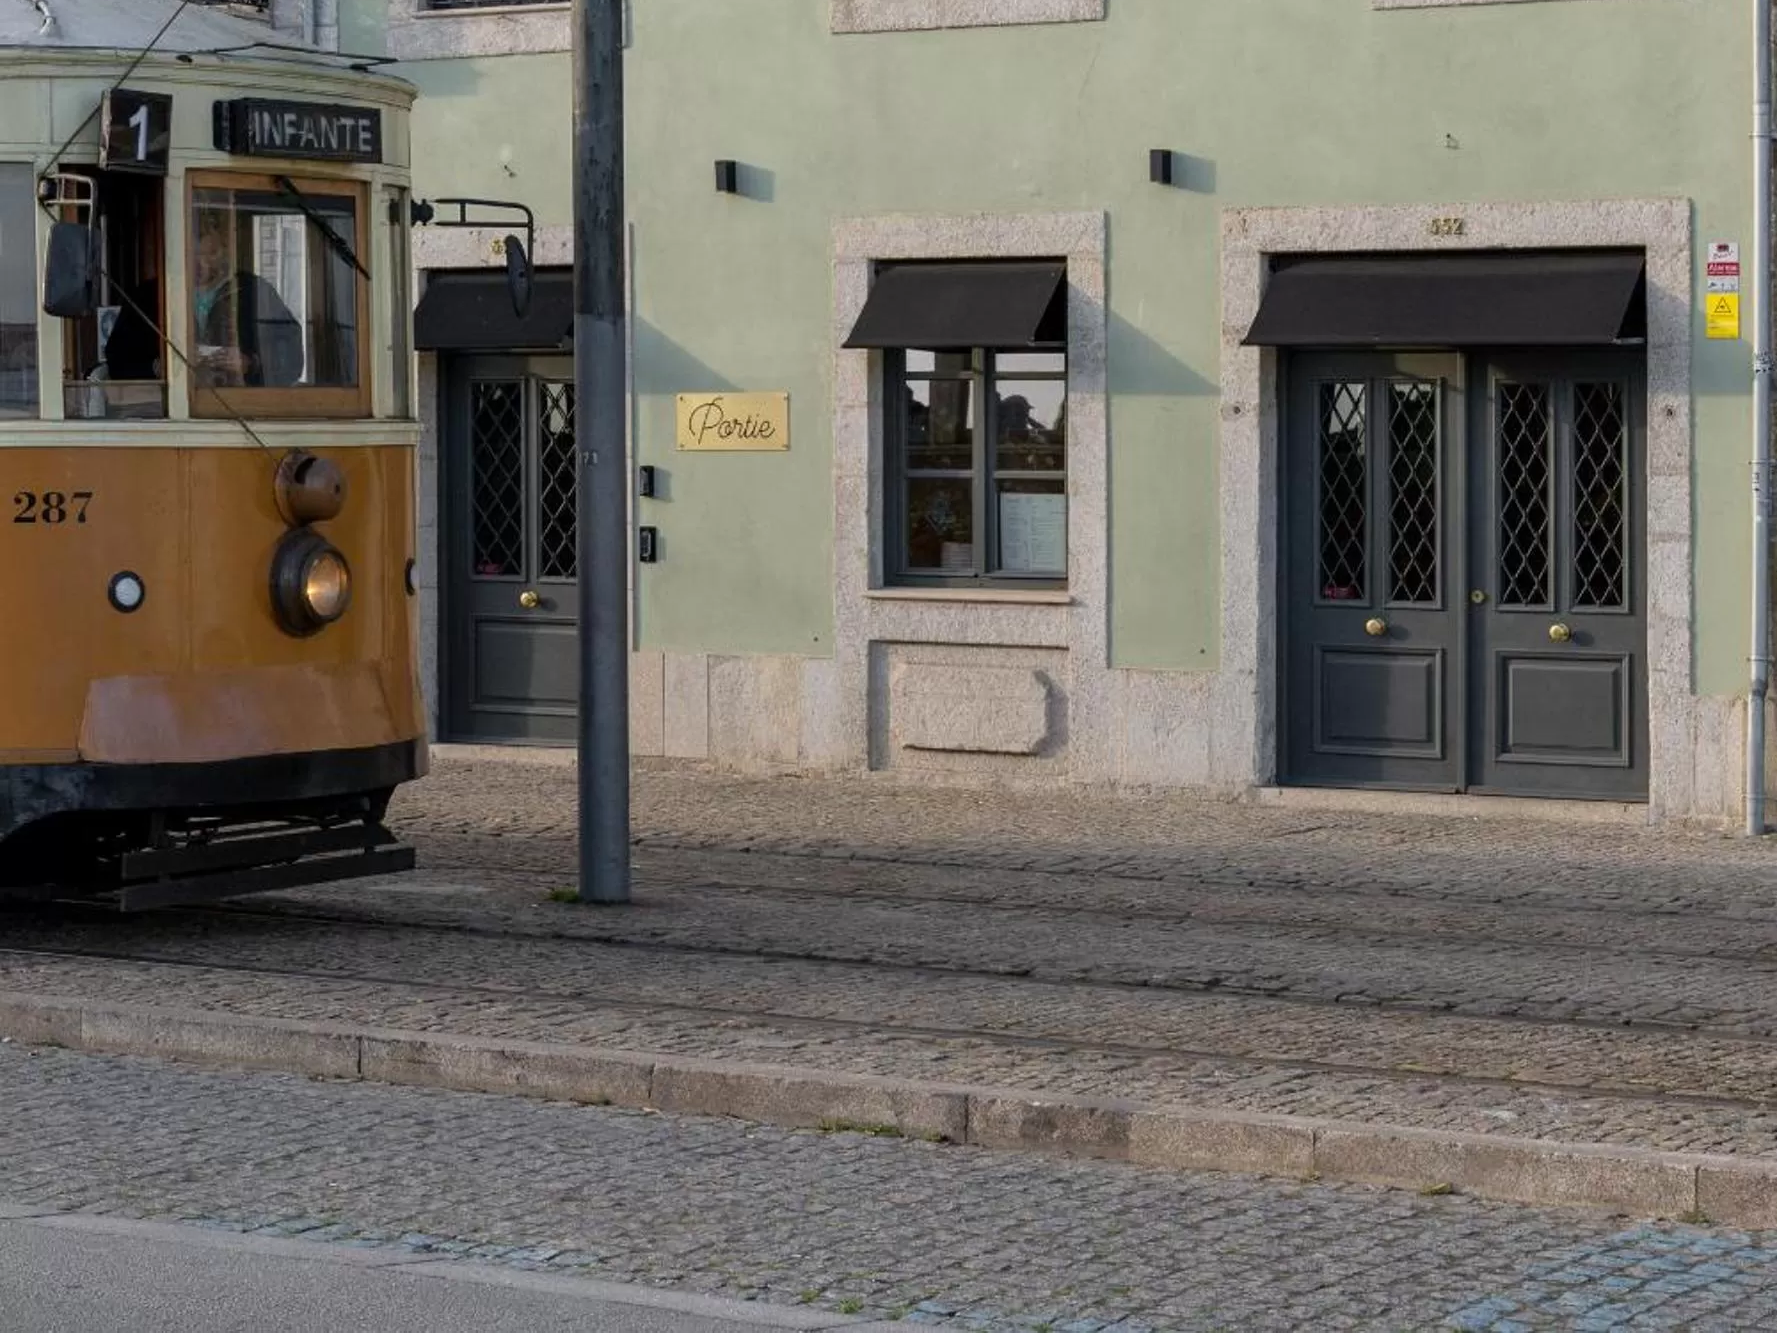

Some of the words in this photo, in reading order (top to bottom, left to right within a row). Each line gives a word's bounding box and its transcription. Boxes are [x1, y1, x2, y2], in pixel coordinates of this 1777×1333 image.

[129, 104, 148, 161] 1
[253, 110, 373, 152] INFANTE
[14, 492, 93, 523] 287
